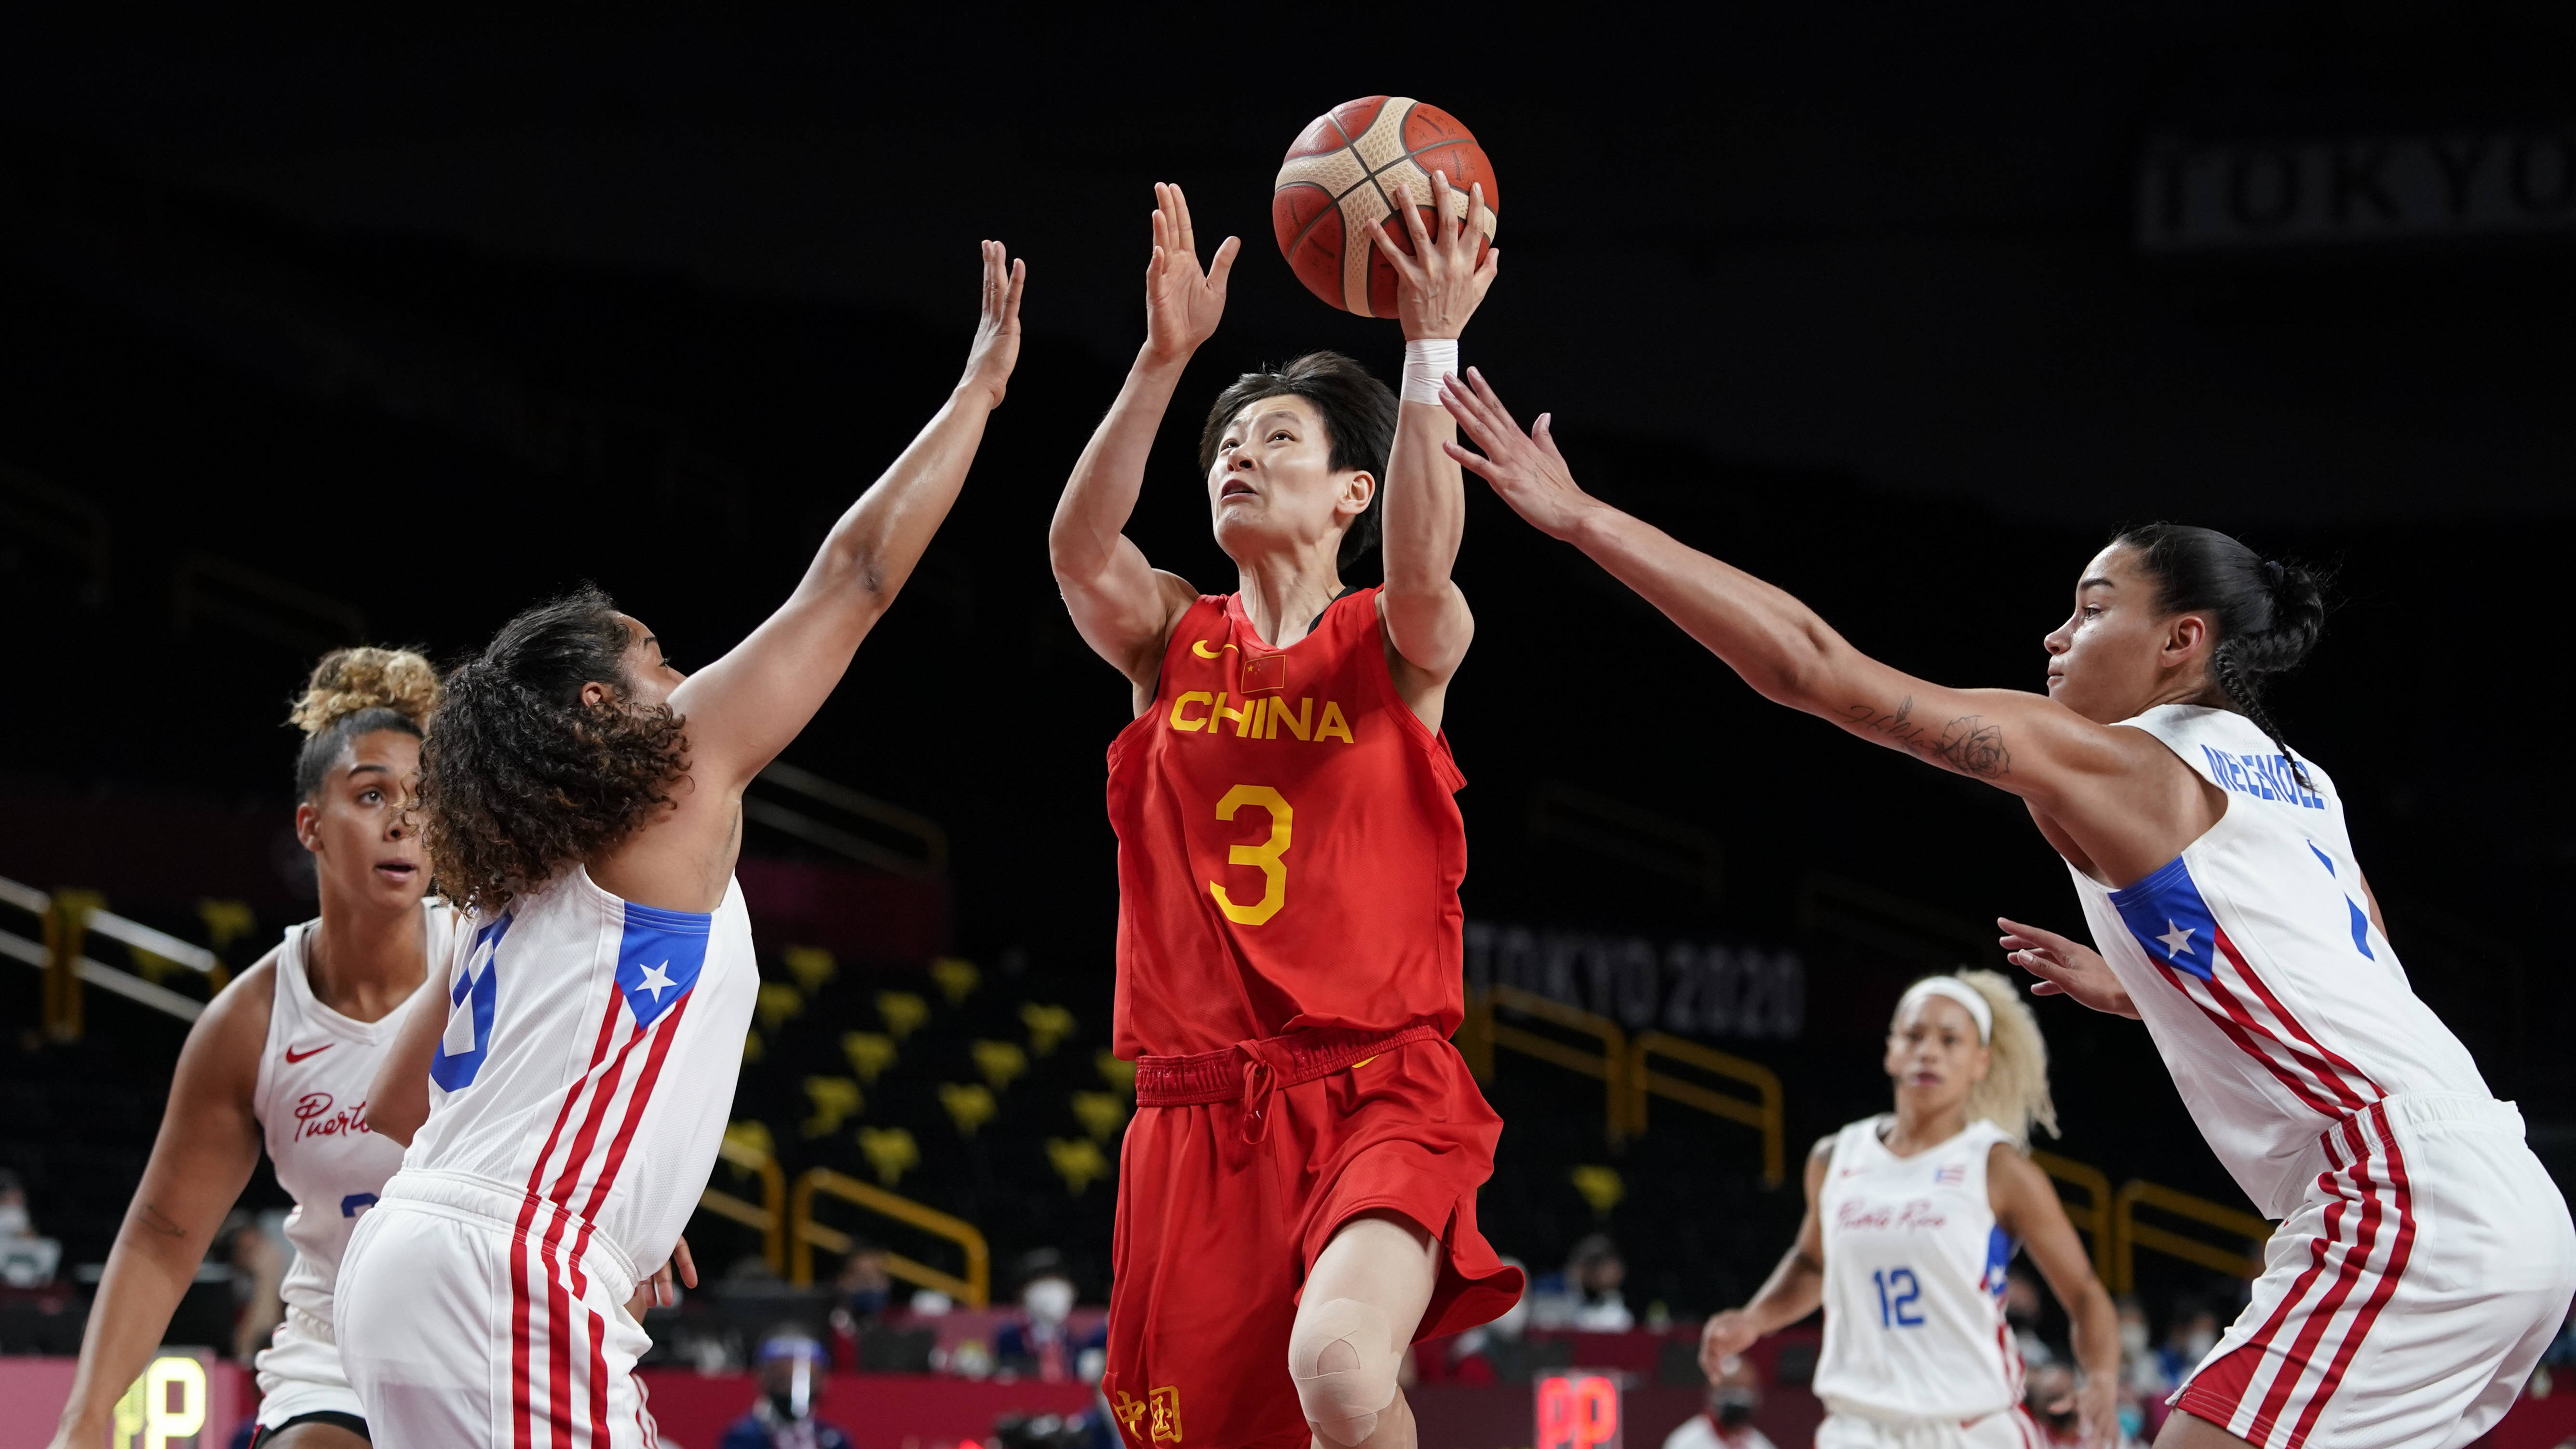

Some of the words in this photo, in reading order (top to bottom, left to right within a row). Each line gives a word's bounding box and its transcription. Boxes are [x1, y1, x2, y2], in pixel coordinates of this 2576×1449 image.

[1169, 691, 1354, 744] CHINA
[1210, 784, 1294, 926] 3
[2306, 839, 2375, 963] 1
[1465, 920, 1659, 1028] TOKYO
[1662, 938, 1809, 1041] 2020
[1837, 1195, 1891, 1231] Puerto
[1898, 1198, 1947, 1230] Rico
[1874, 1265, 1924, 1329] 12
[1112, 1385, 1183, 1443] 中国
